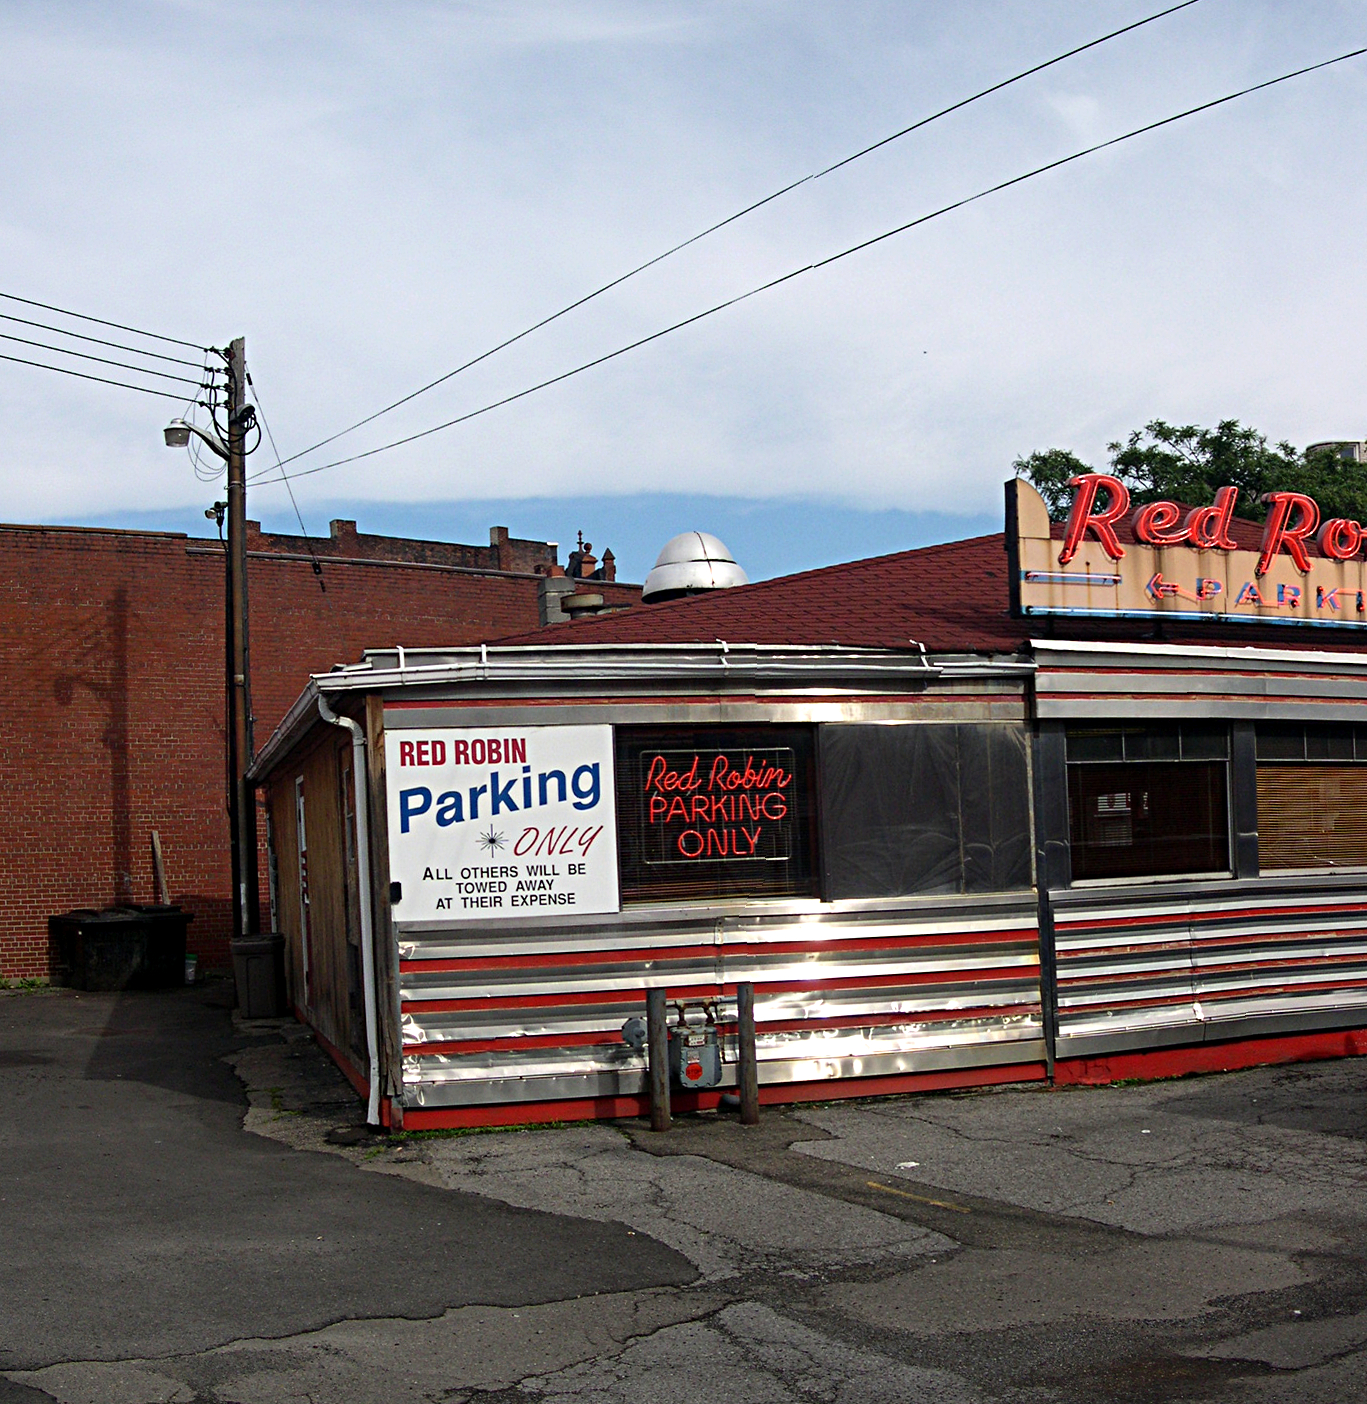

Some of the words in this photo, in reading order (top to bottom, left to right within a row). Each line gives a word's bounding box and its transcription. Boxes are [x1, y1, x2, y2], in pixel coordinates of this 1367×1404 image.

[1057, 473, 1238, 565] Red
[400, 740, 446, 766] RED
[455, 738, 527, 765] ROBIN
[645, 755, 702, 793] Red
[707, 755, 793, 791] Robin
[399, 762, 600, 834] Parking
[650, 792, 787, 823] PARKING
[513, 825, 604, 857] ONLY
[678, 826, 761, 857] ONLY
[422, 867, 453, 881] ALL
[460, 866, 519, 880] OTHERS
[526, 864, 560, 876] WILL
[567, 863, 587, 875] BE
[456, 881, 507, 894] TOWED
[515, 879, 555, 892] AWAY
[436, 897, 453, 910] AT
[461, 896, 503, 909] THEIR
[511, 892, 576, 907] EXPENSE
